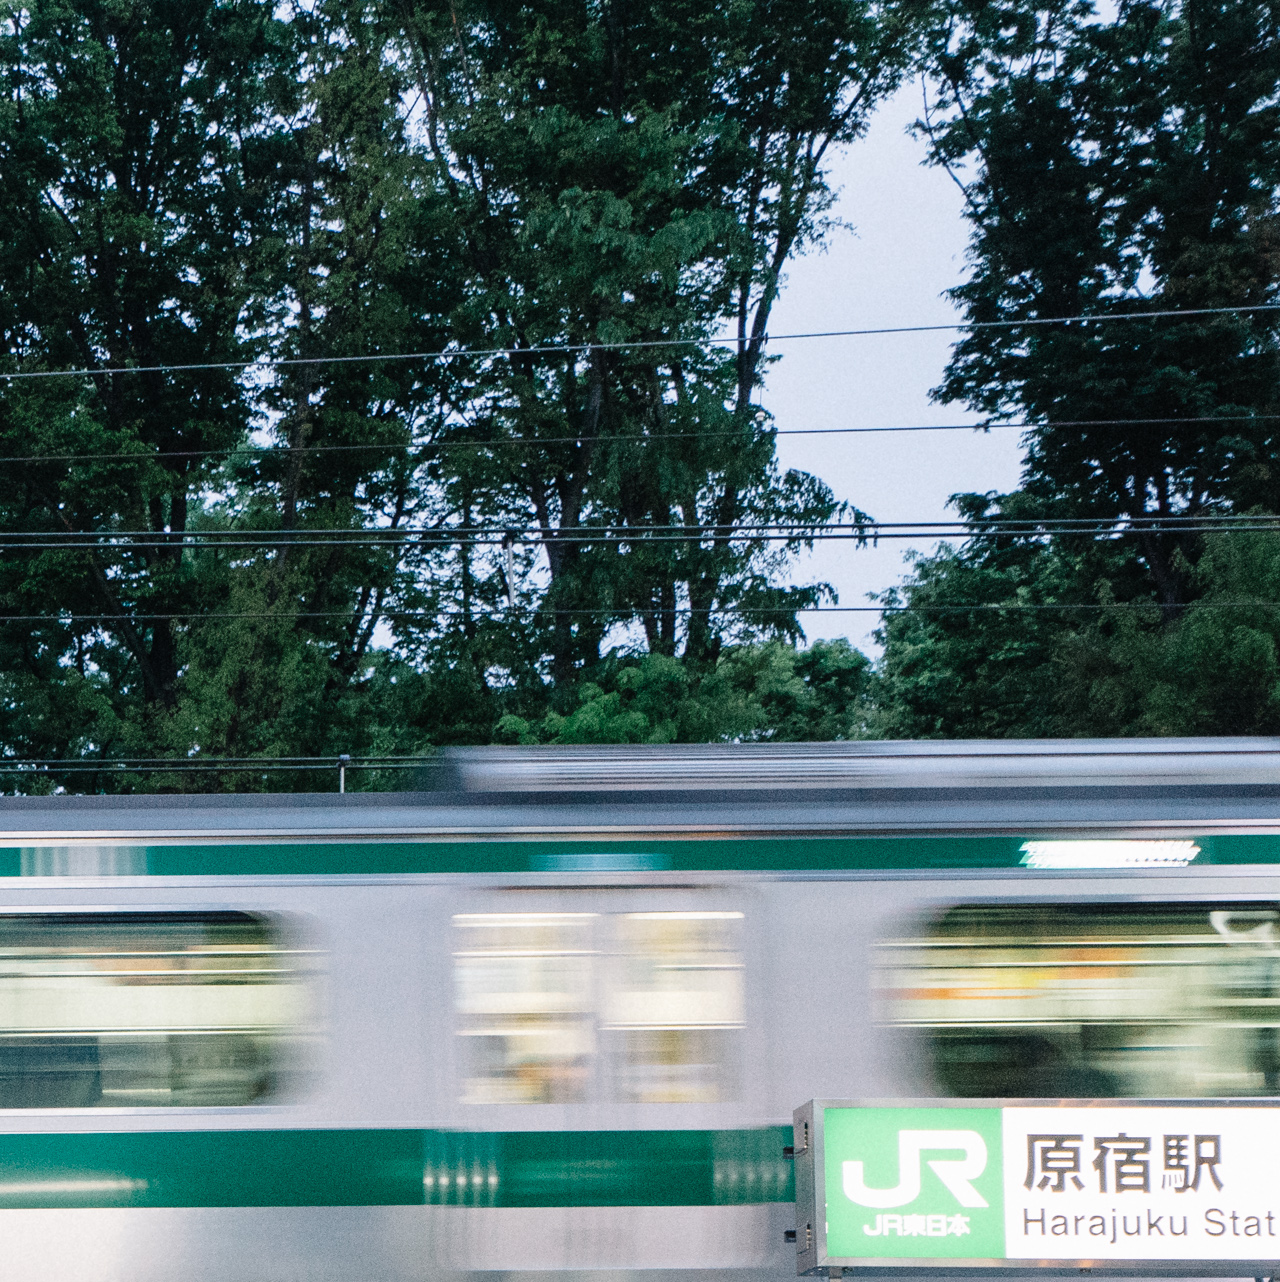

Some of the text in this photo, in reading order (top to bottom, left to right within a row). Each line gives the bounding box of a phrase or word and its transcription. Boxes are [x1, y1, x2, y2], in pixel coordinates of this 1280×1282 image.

[842, 1130, 990, 1209] JR
[1023, 1132, 1224, 1195] 原宿駅
[863, 1213, 971, 1238] JR東日本
[1023, 1208, 1189, 1244] Harajuku
